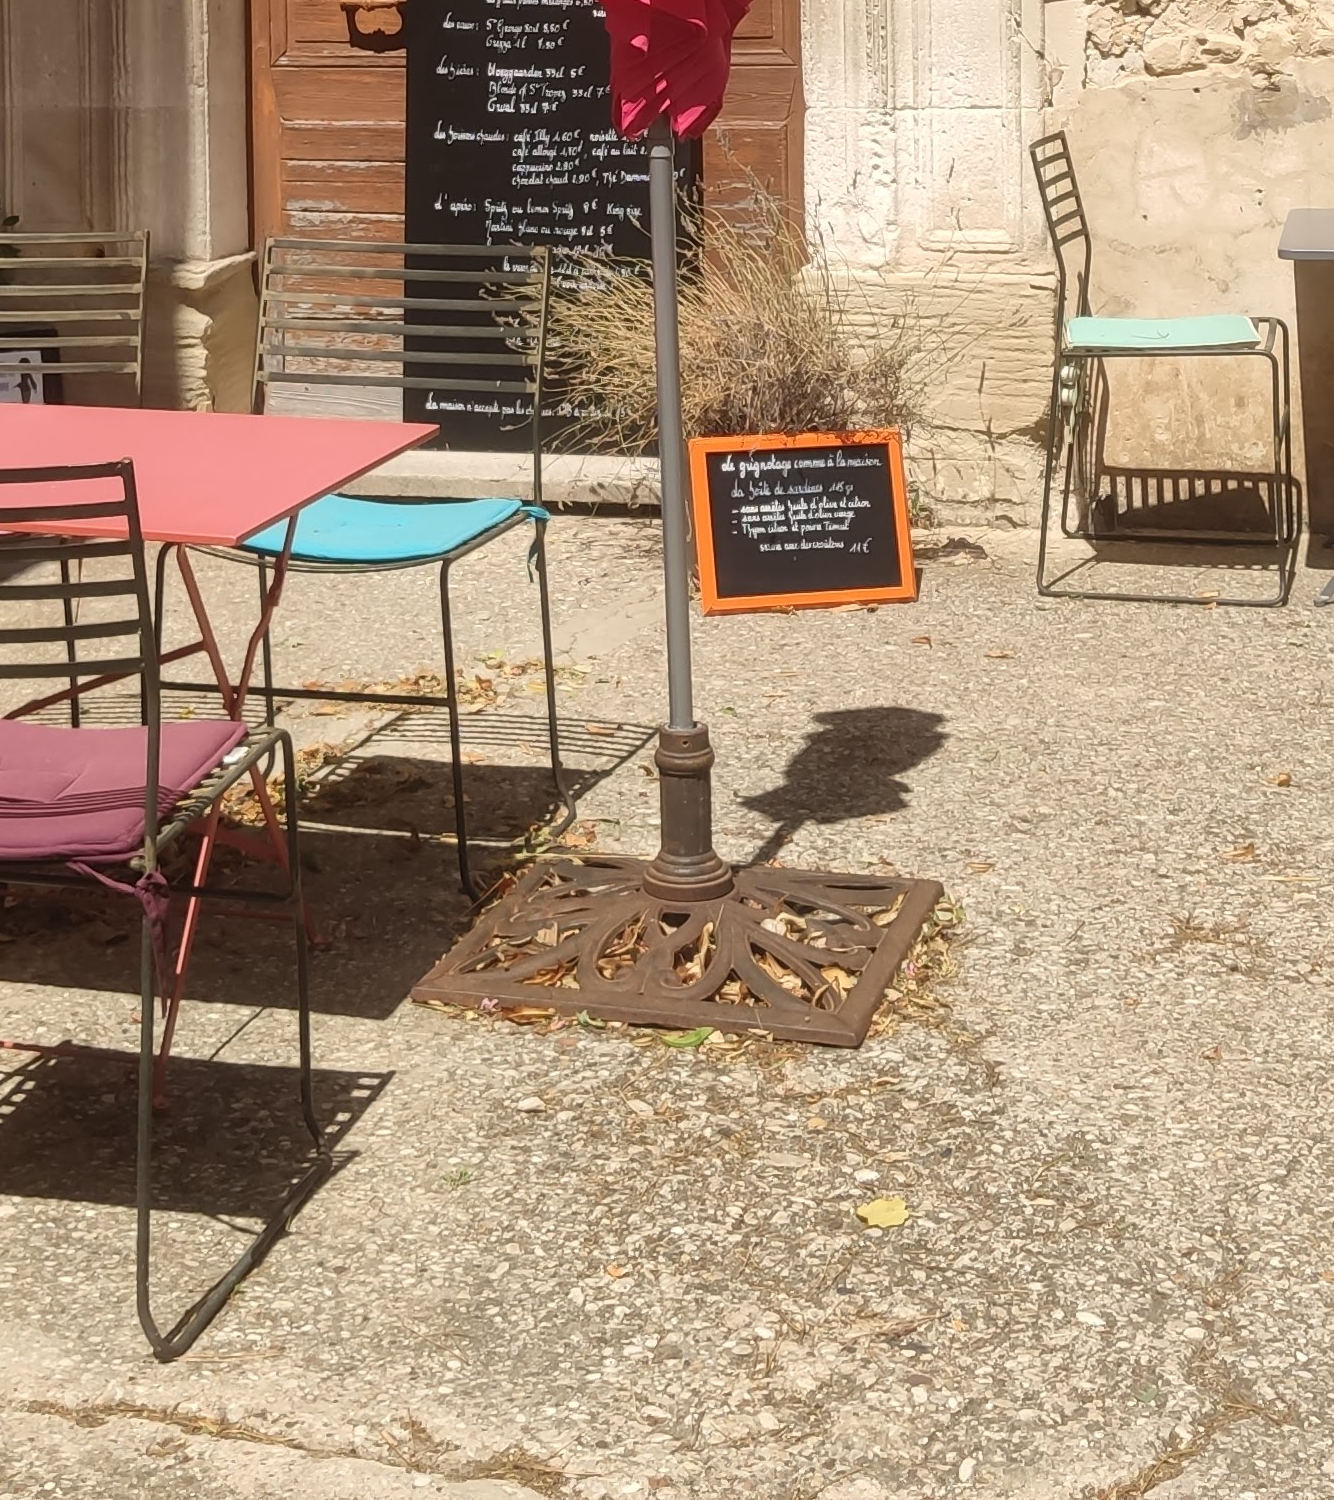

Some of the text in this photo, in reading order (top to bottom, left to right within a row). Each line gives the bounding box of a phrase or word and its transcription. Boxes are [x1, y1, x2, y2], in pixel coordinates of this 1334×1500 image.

[512, 205, 523, 214] ou
[540, 226, 551, 235] ou
[739, 453, 792, 478] grignotage
[794, 457, 825, 469] comme
[836, 449, 847, 468] la
[847, 453, 882, 468] maison
[774, 480, 785, 495] de
[785, 479, 823, 495] sardines
[741, 505, 758, 513] sans
[741, 514, 760, 522] sans
